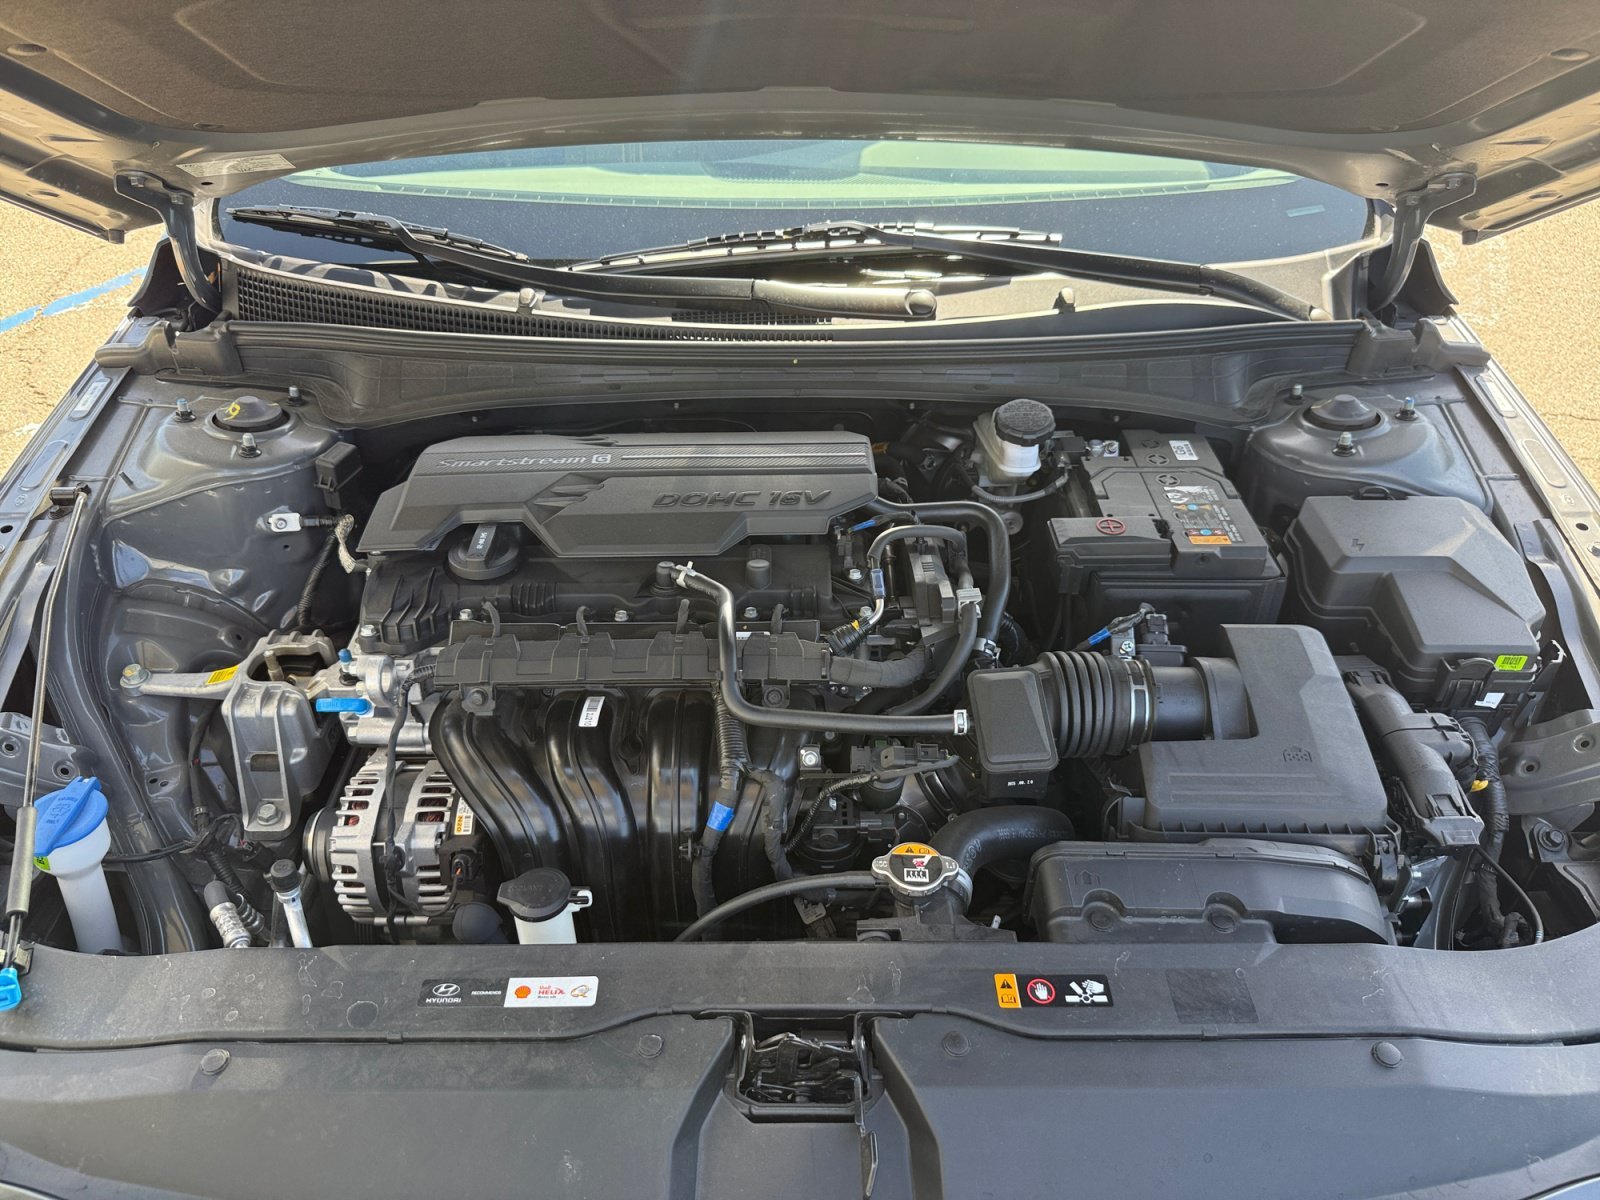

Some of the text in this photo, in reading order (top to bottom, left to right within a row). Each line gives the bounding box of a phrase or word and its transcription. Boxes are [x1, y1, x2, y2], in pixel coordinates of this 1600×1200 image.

[436, 454, 612, 469] Smartstream G
[652, 489, 832, 508] DOHC 16V
